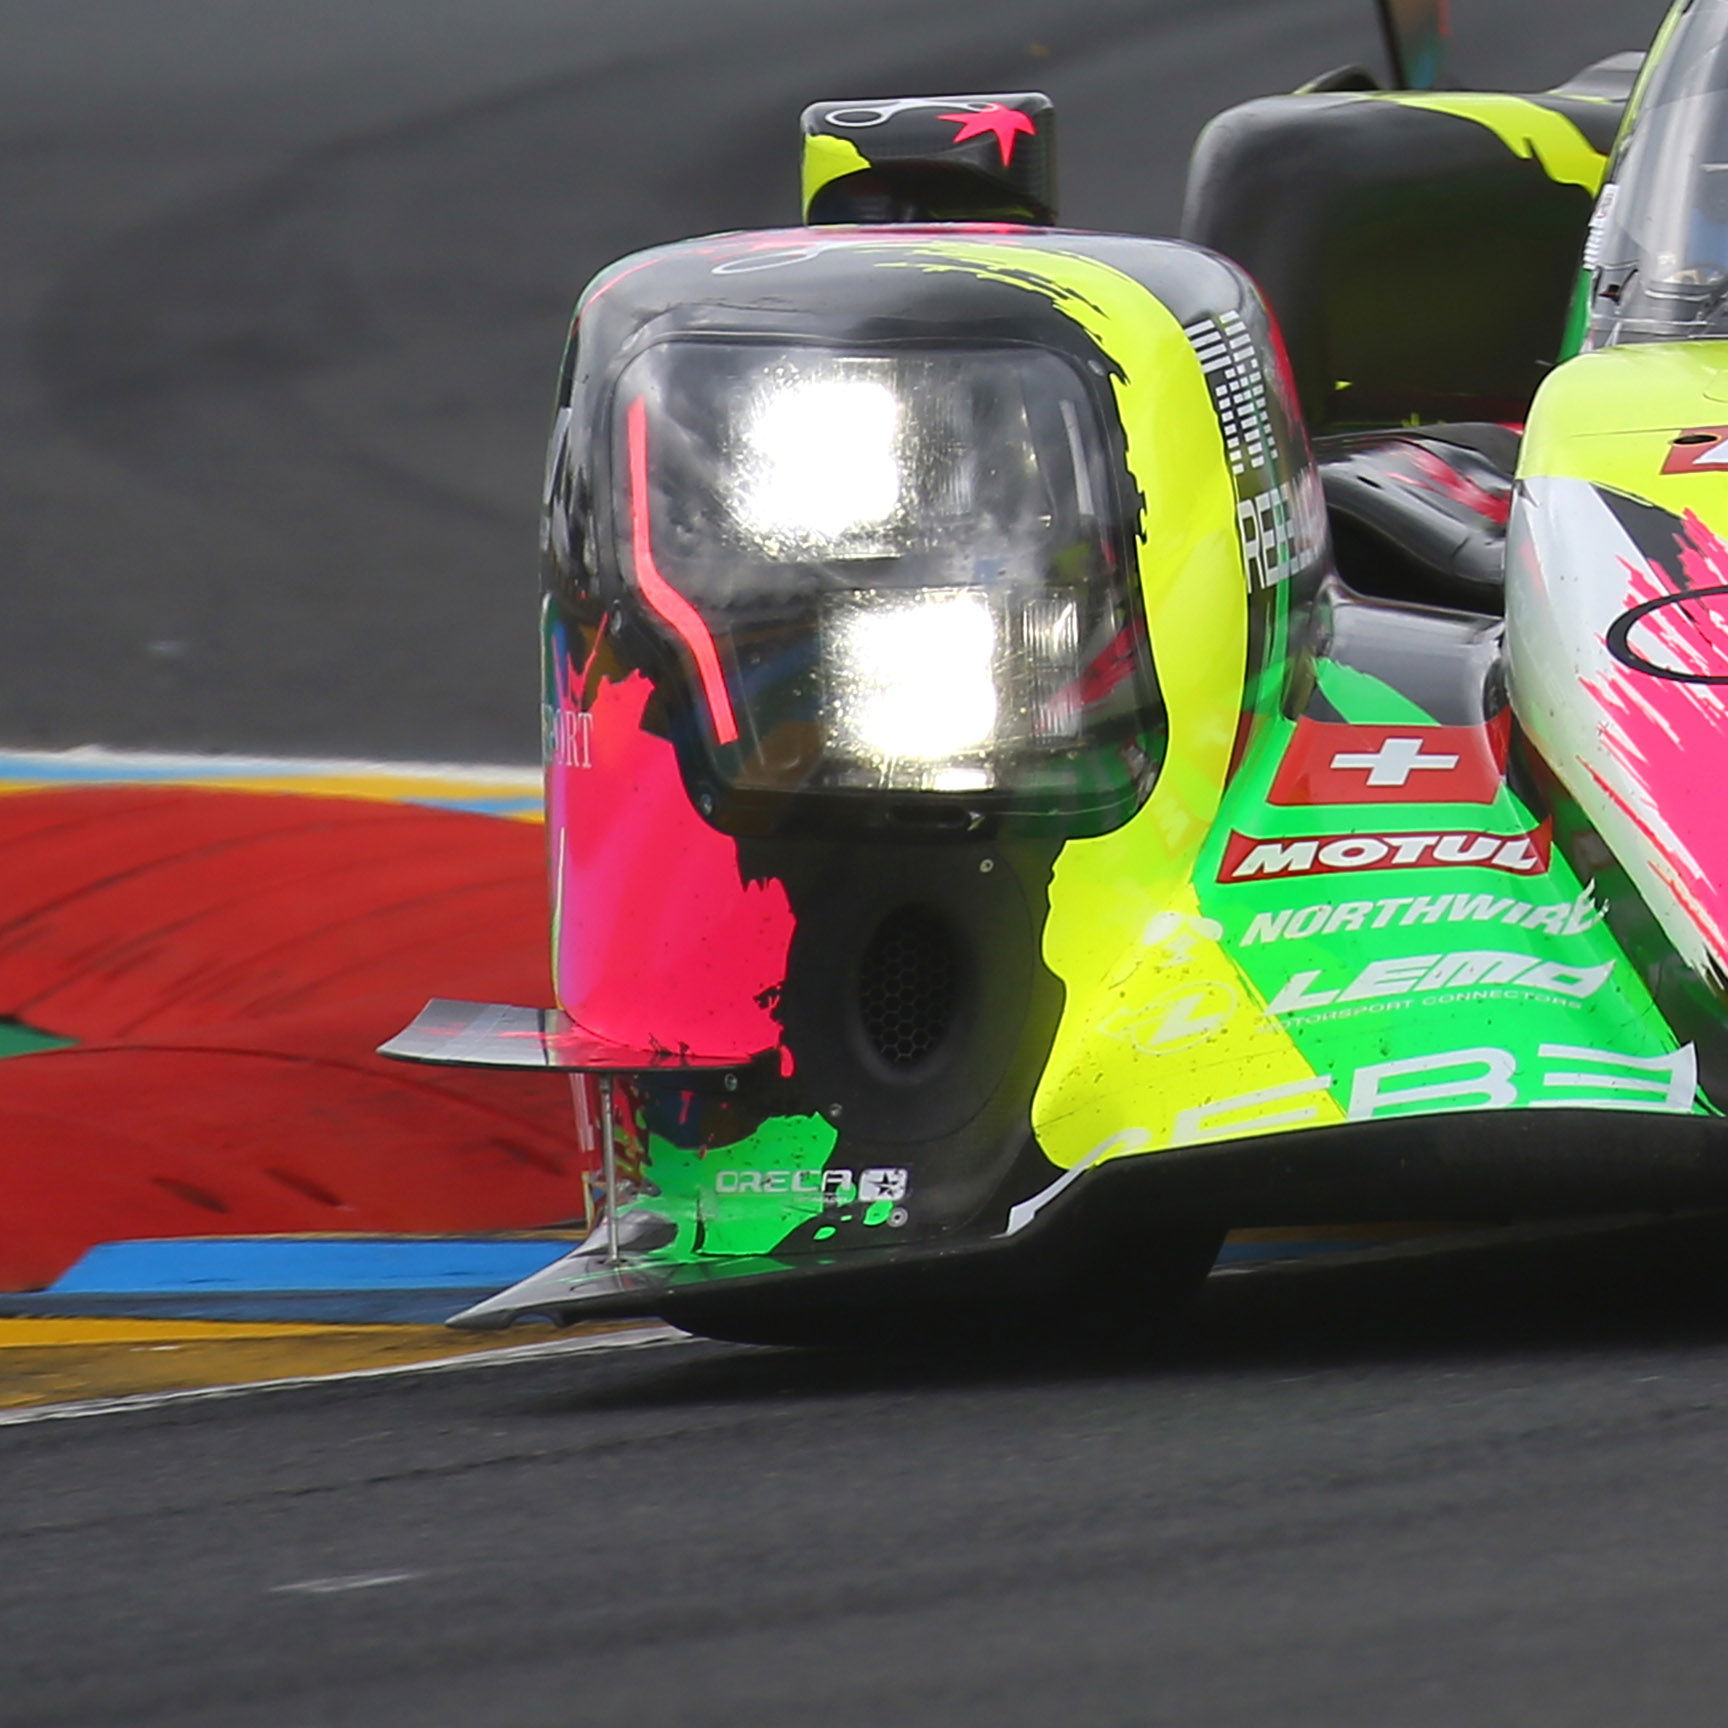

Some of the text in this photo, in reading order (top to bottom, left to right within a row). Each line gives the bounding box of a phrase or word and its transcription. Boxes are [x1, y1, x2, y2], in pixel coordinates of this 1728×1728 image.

[1230, 834, 1540, 879] MOTUL
[1239, 877, 1600, 947] NORTHWIRE
[1263, 949, 1616, 1017] LEMO
[1422, 988, 1583, 1010] CONNECTORS
[716, 1169, 853, 1194] ORECA
